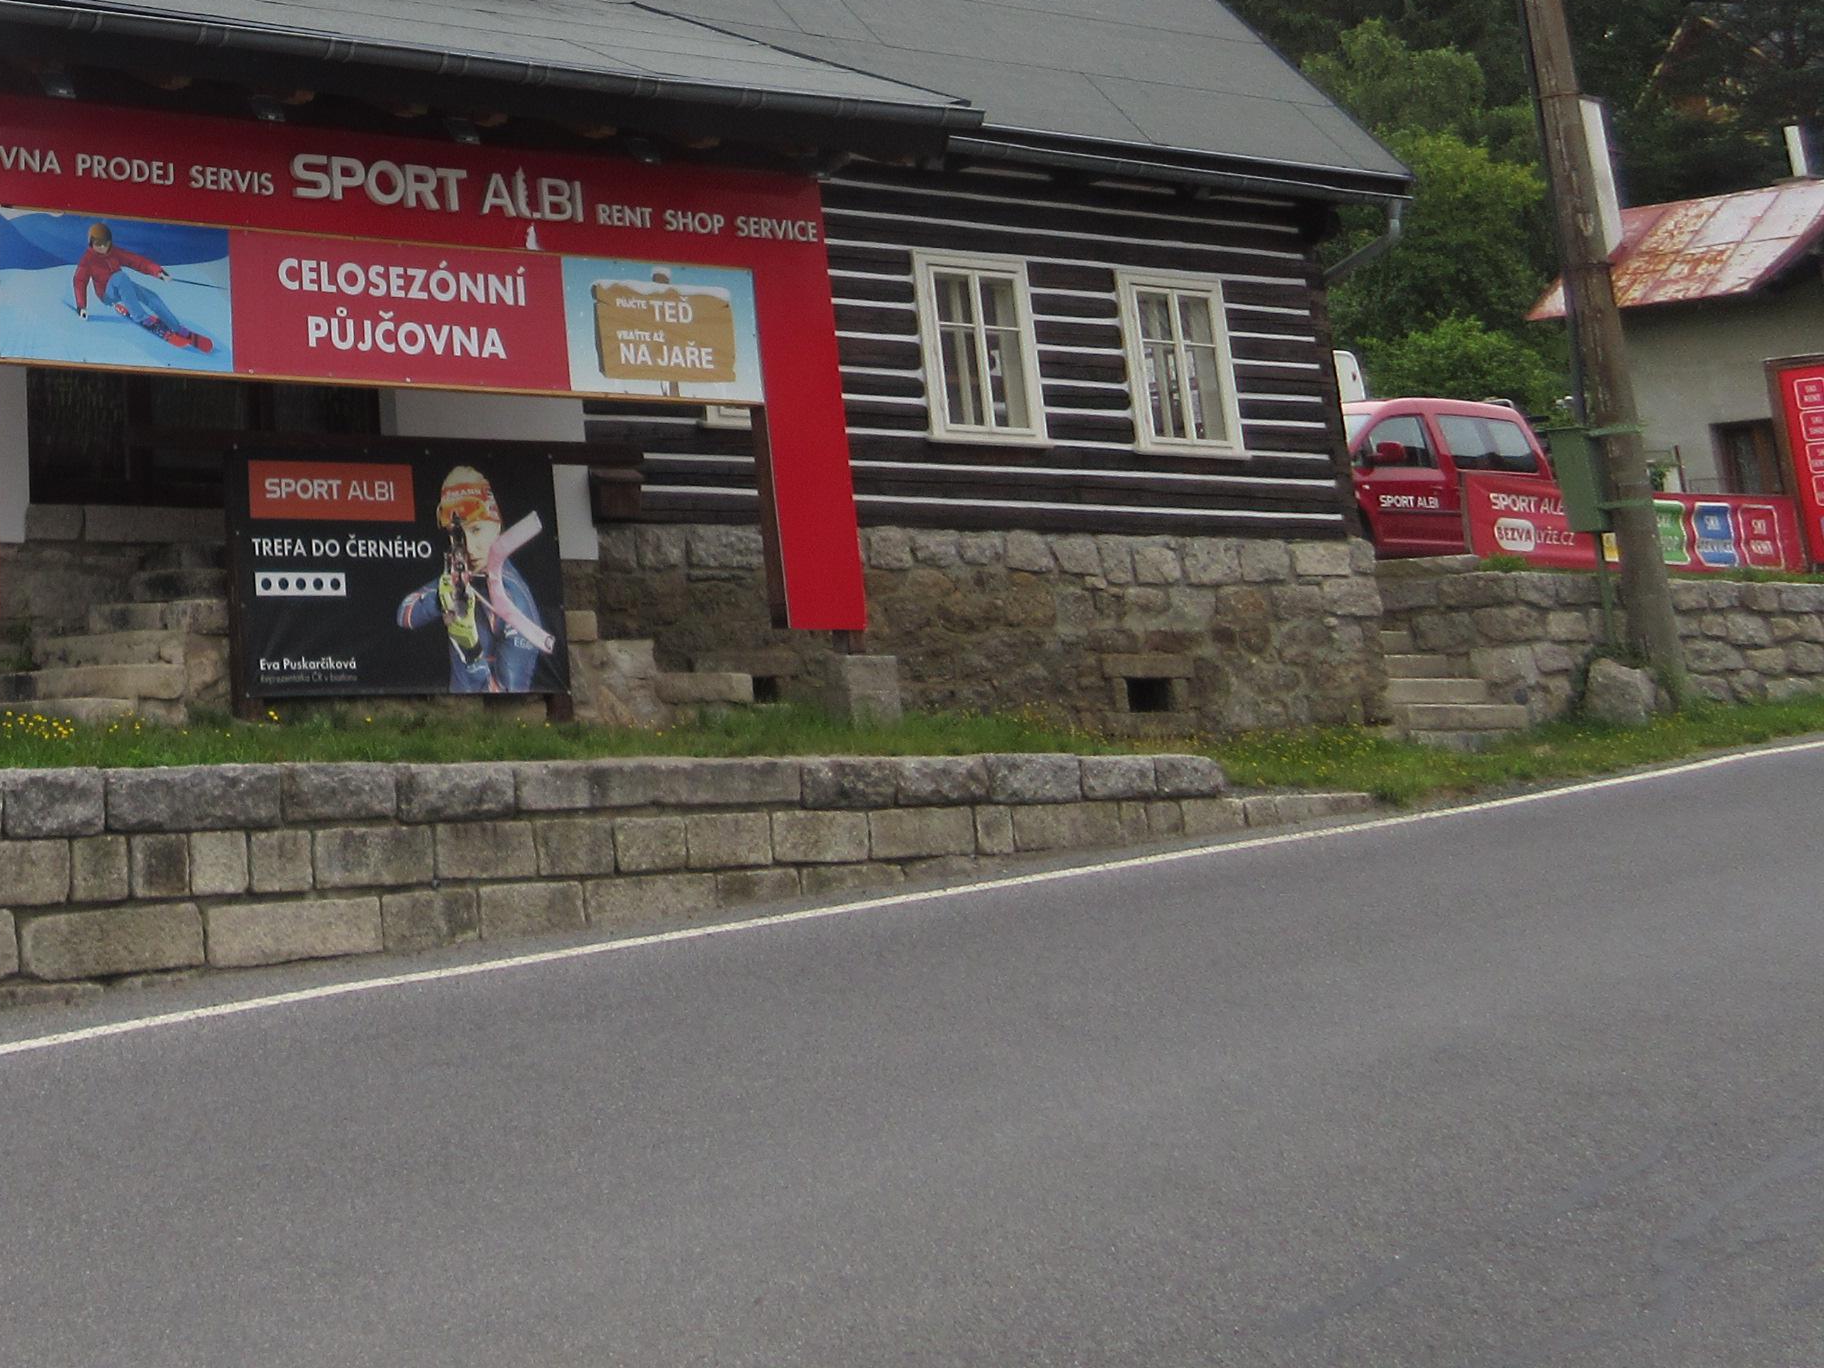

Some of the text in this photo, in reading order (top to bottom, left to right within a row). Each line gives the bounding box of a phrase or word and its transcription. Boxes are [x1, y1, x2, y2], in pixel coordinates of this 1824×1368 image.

[76, 154, 175, 186] PRODEJ
[189, 165, 274, 196] SERVIS
[290, 153, 584, 223] SPORT ALBI
[596, 203, 818, 243] RENT SHOP SERVICE
[278, 260, 526, 307] CELOSEZÓNNÍ
[649, 296, 693, 323] TEĎ
[306, 306, 507, 360] PŮJČOVNA
[620, 340, 714, 369] NA JAŘE
[265, 478, 395, 501] SPORT ALBI
[1379, 494, 1439, 509] SPORT ALBI
[1489, 492, 1565, 516] SPORT AL
[252, 534, 432, 558] TREFA DO ČERNÉHO
[259, 658, 280, 671] Eva
